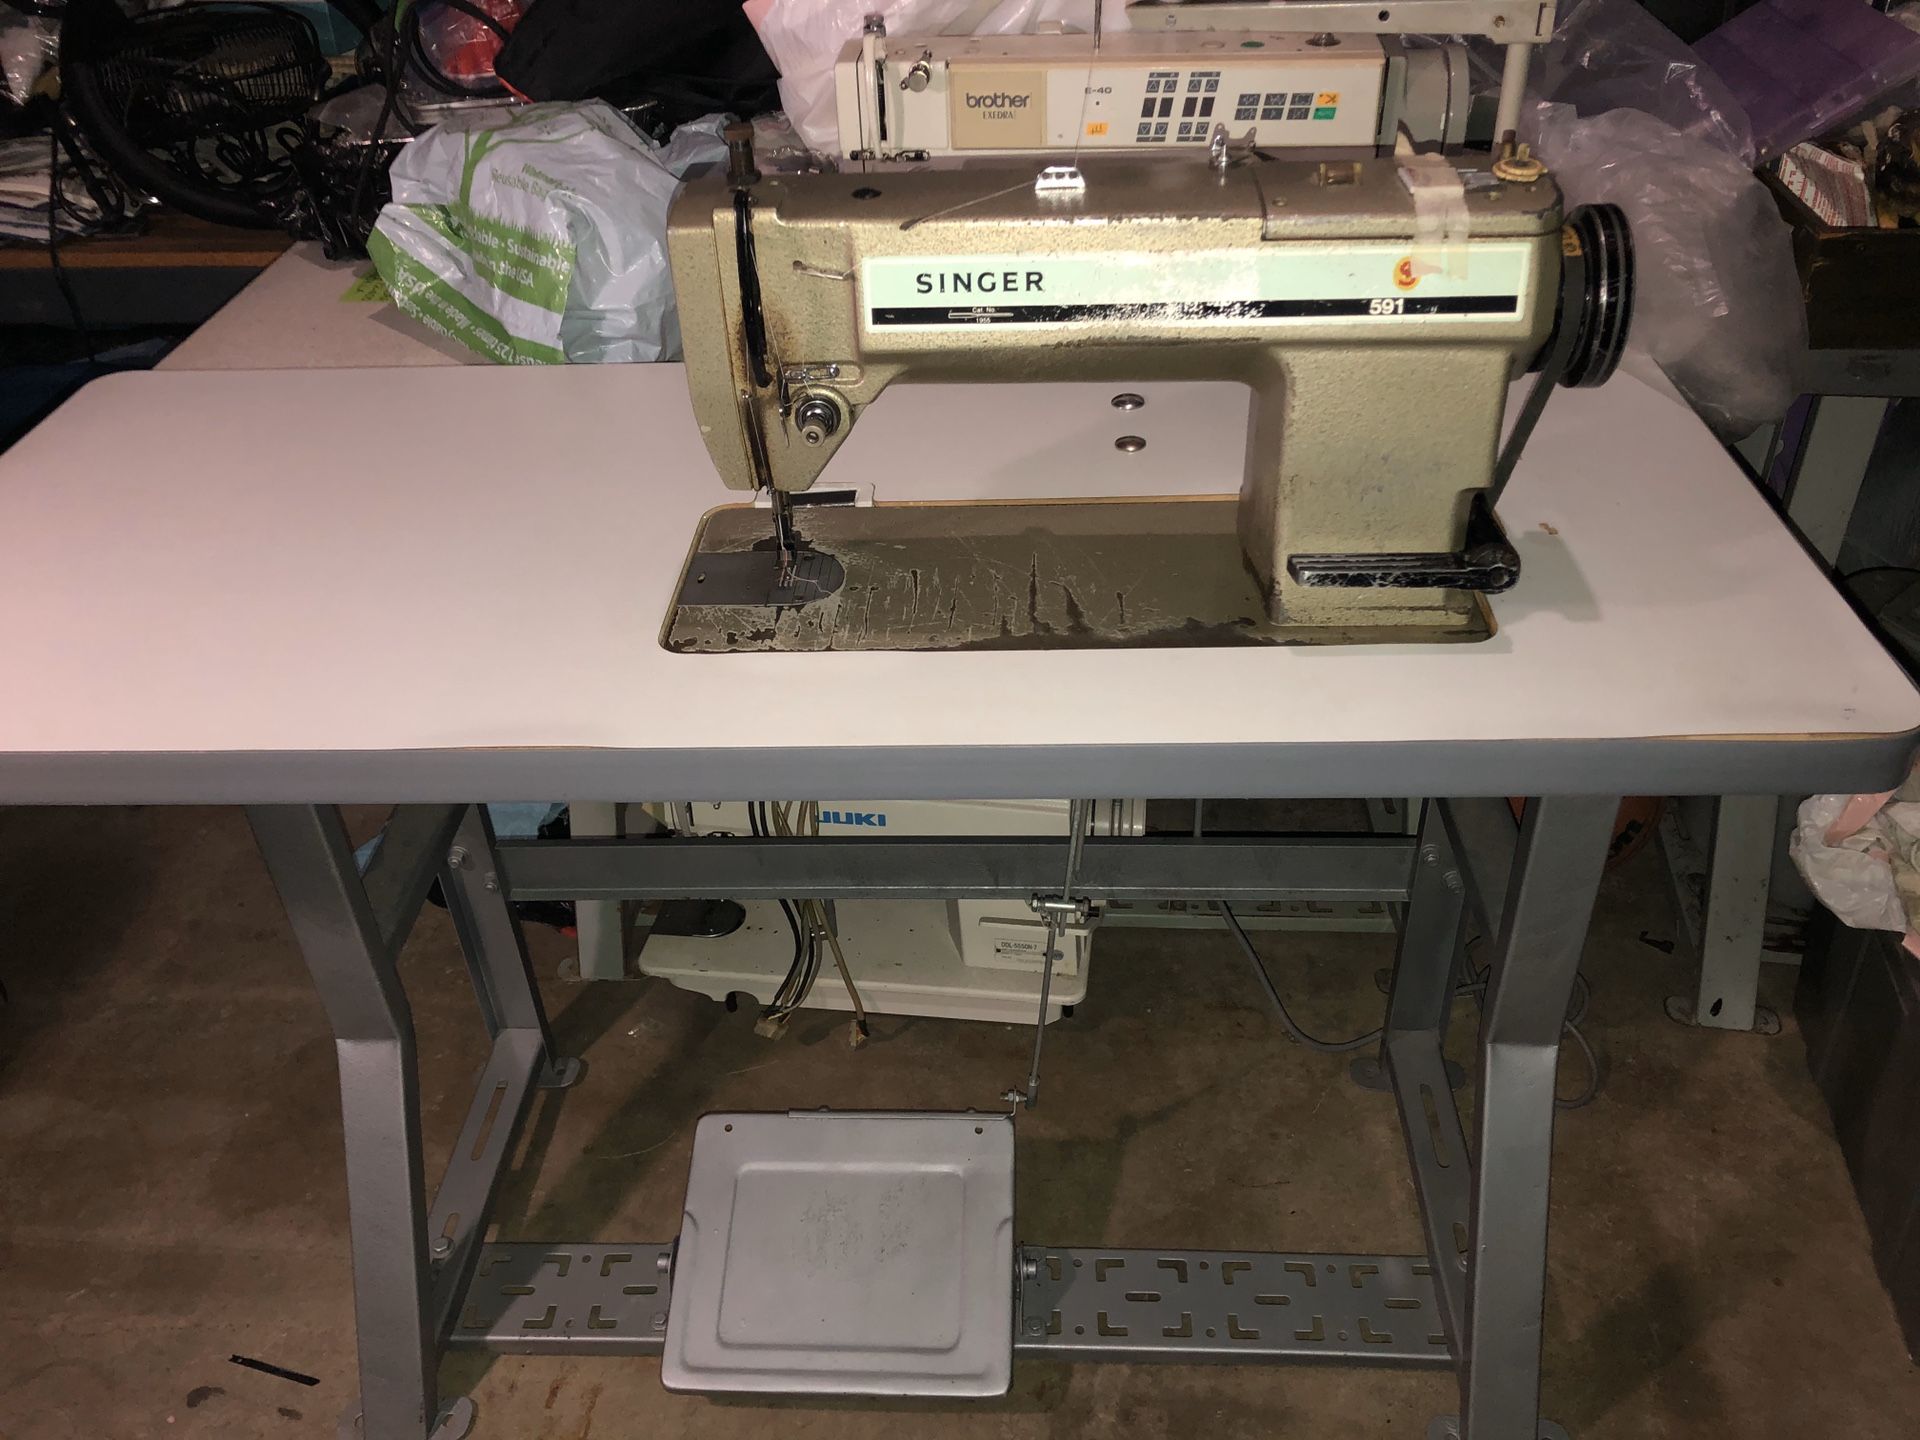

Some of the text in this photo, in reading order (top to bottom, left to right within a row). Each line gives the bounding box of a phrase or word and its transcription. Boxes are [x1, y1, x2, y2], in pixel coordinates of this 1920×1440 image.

[965, 92, 1030, 108] brother
[916, 271, 1044, 294] SINGER
[1369, 298, 1404, 314] 591
[815, 811, 886, 827] JUKI
